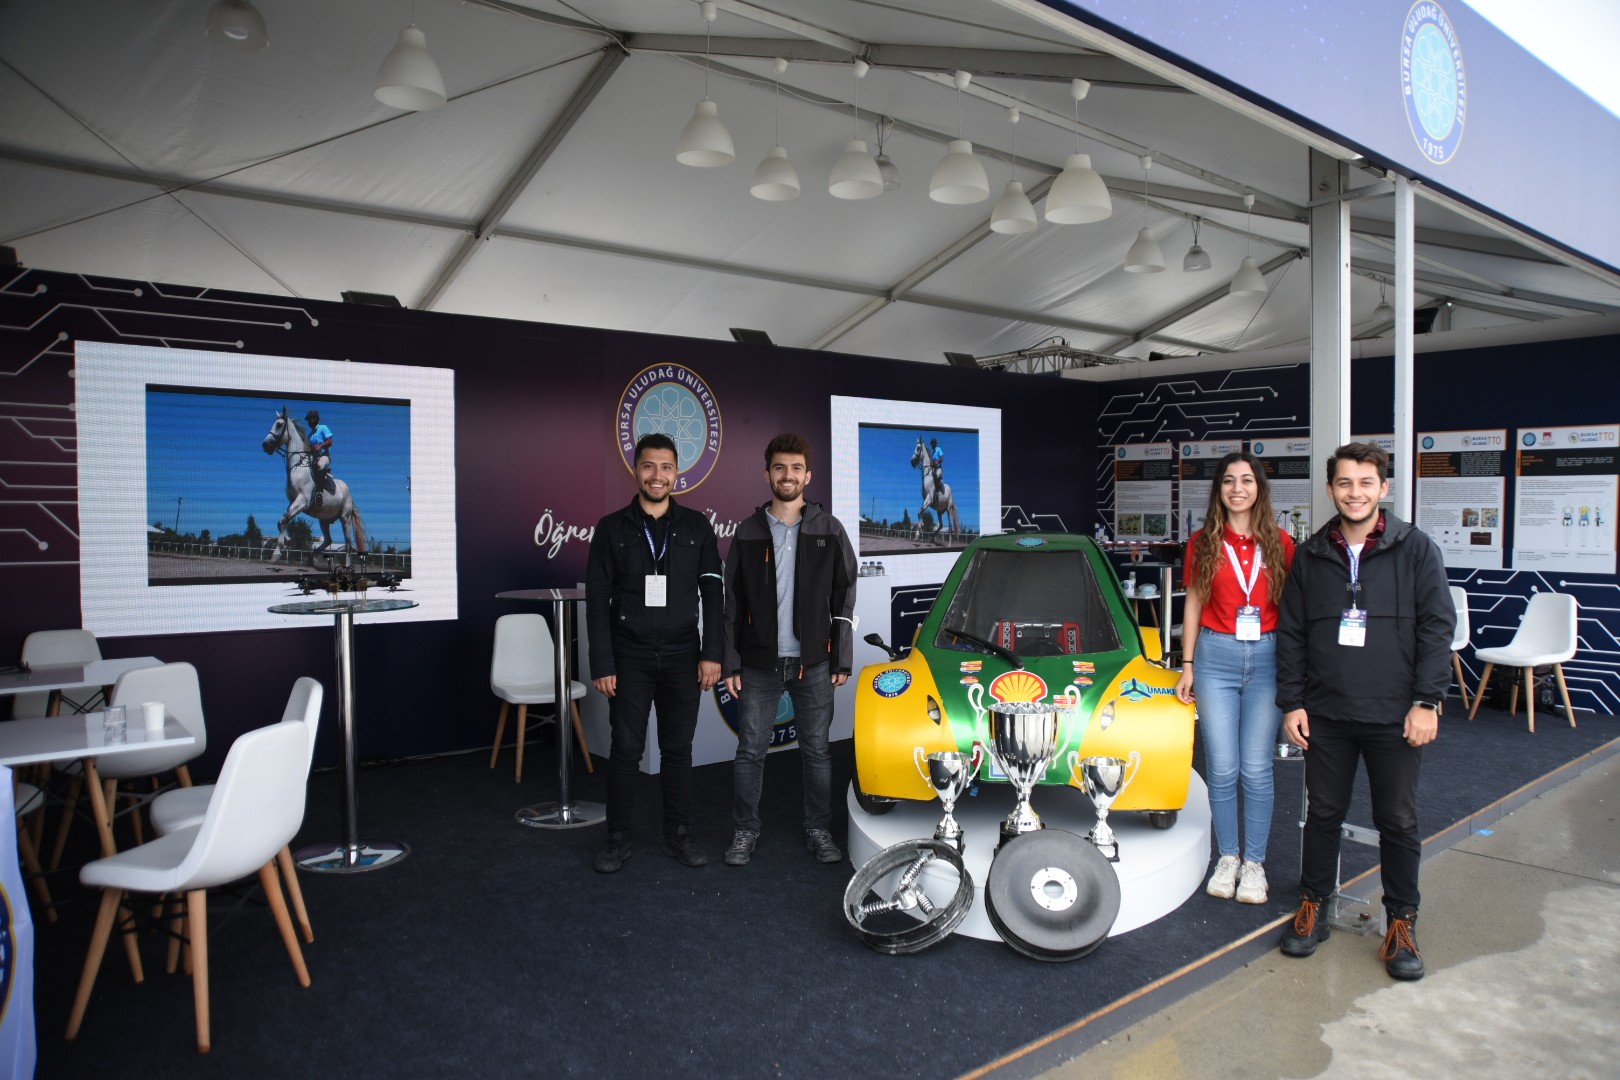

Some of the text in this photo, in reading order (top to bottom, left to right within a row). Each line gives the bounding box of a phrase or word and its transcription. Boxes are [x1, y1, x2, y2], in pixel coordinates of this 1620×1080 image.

[1403, 35, 1413, 95] BURSA
[1408, 5, 1438, 33] ULUDAĞ
[1423, 138, 1444, 159] 1975
[620, 402, 633, 452] BURSA
[628, 366, 674, 399] ULUDAĞ
[1003, 621, 1011, 651] sparc
